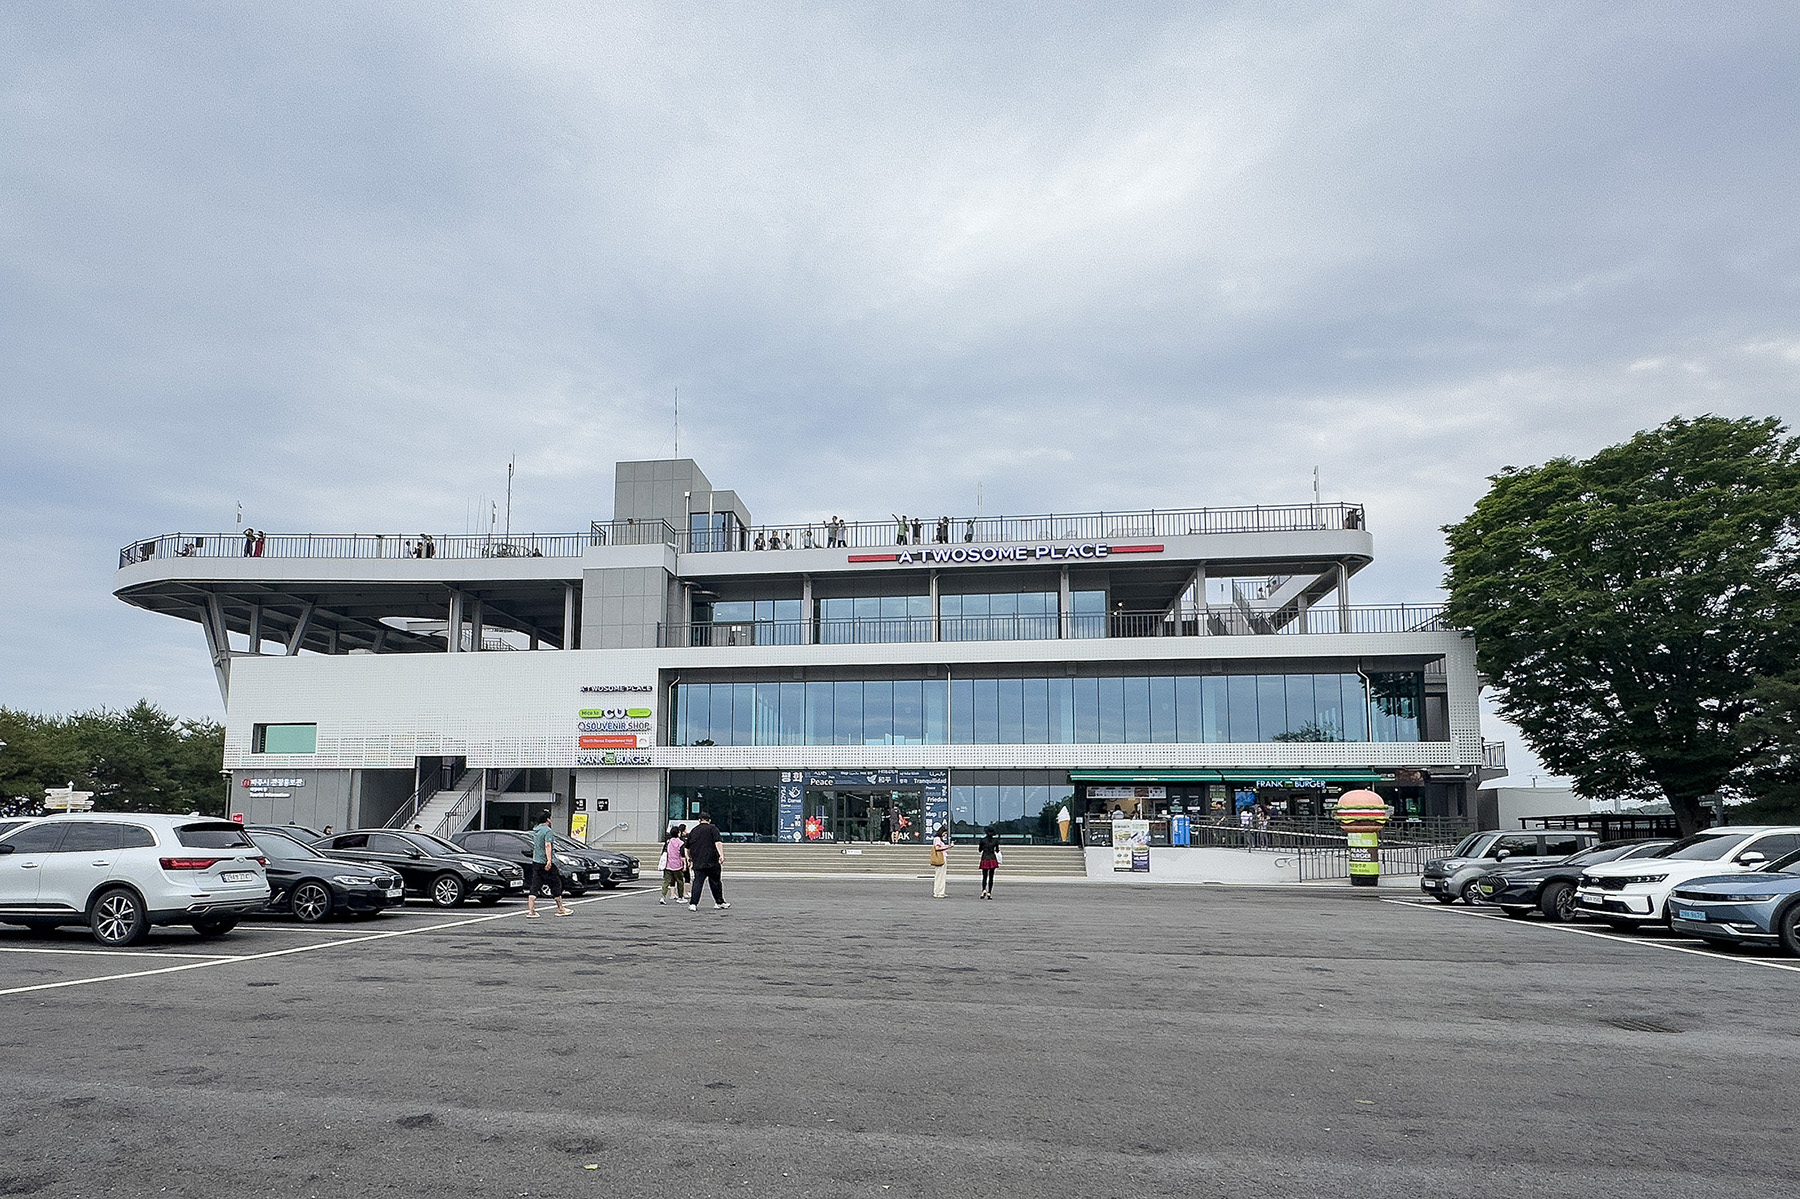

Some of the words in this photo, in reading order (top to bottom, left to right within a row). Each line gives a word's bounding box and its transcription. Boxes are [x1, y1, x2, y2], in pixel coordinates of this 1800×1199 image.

[898, 549, 913, 563] A
[917, 545, 1028, 563] TWOSOME
[1035, 543, 1108, 560] PLACE
[603, 708, 626, 719] CU
[586, 722, 626, 730] SOUVENIR
[628, 722, 650, 730] SHOP
[577, 755, 604, 764] FRANK
[616, 755, 652, 764] BURGER
[781, 772, 803, 783] 평화
[810, 778, 834, 786] Peace
[1256, 780, 1283, 788] FRANK
[1294, 780, 1326, 788] BURGER
